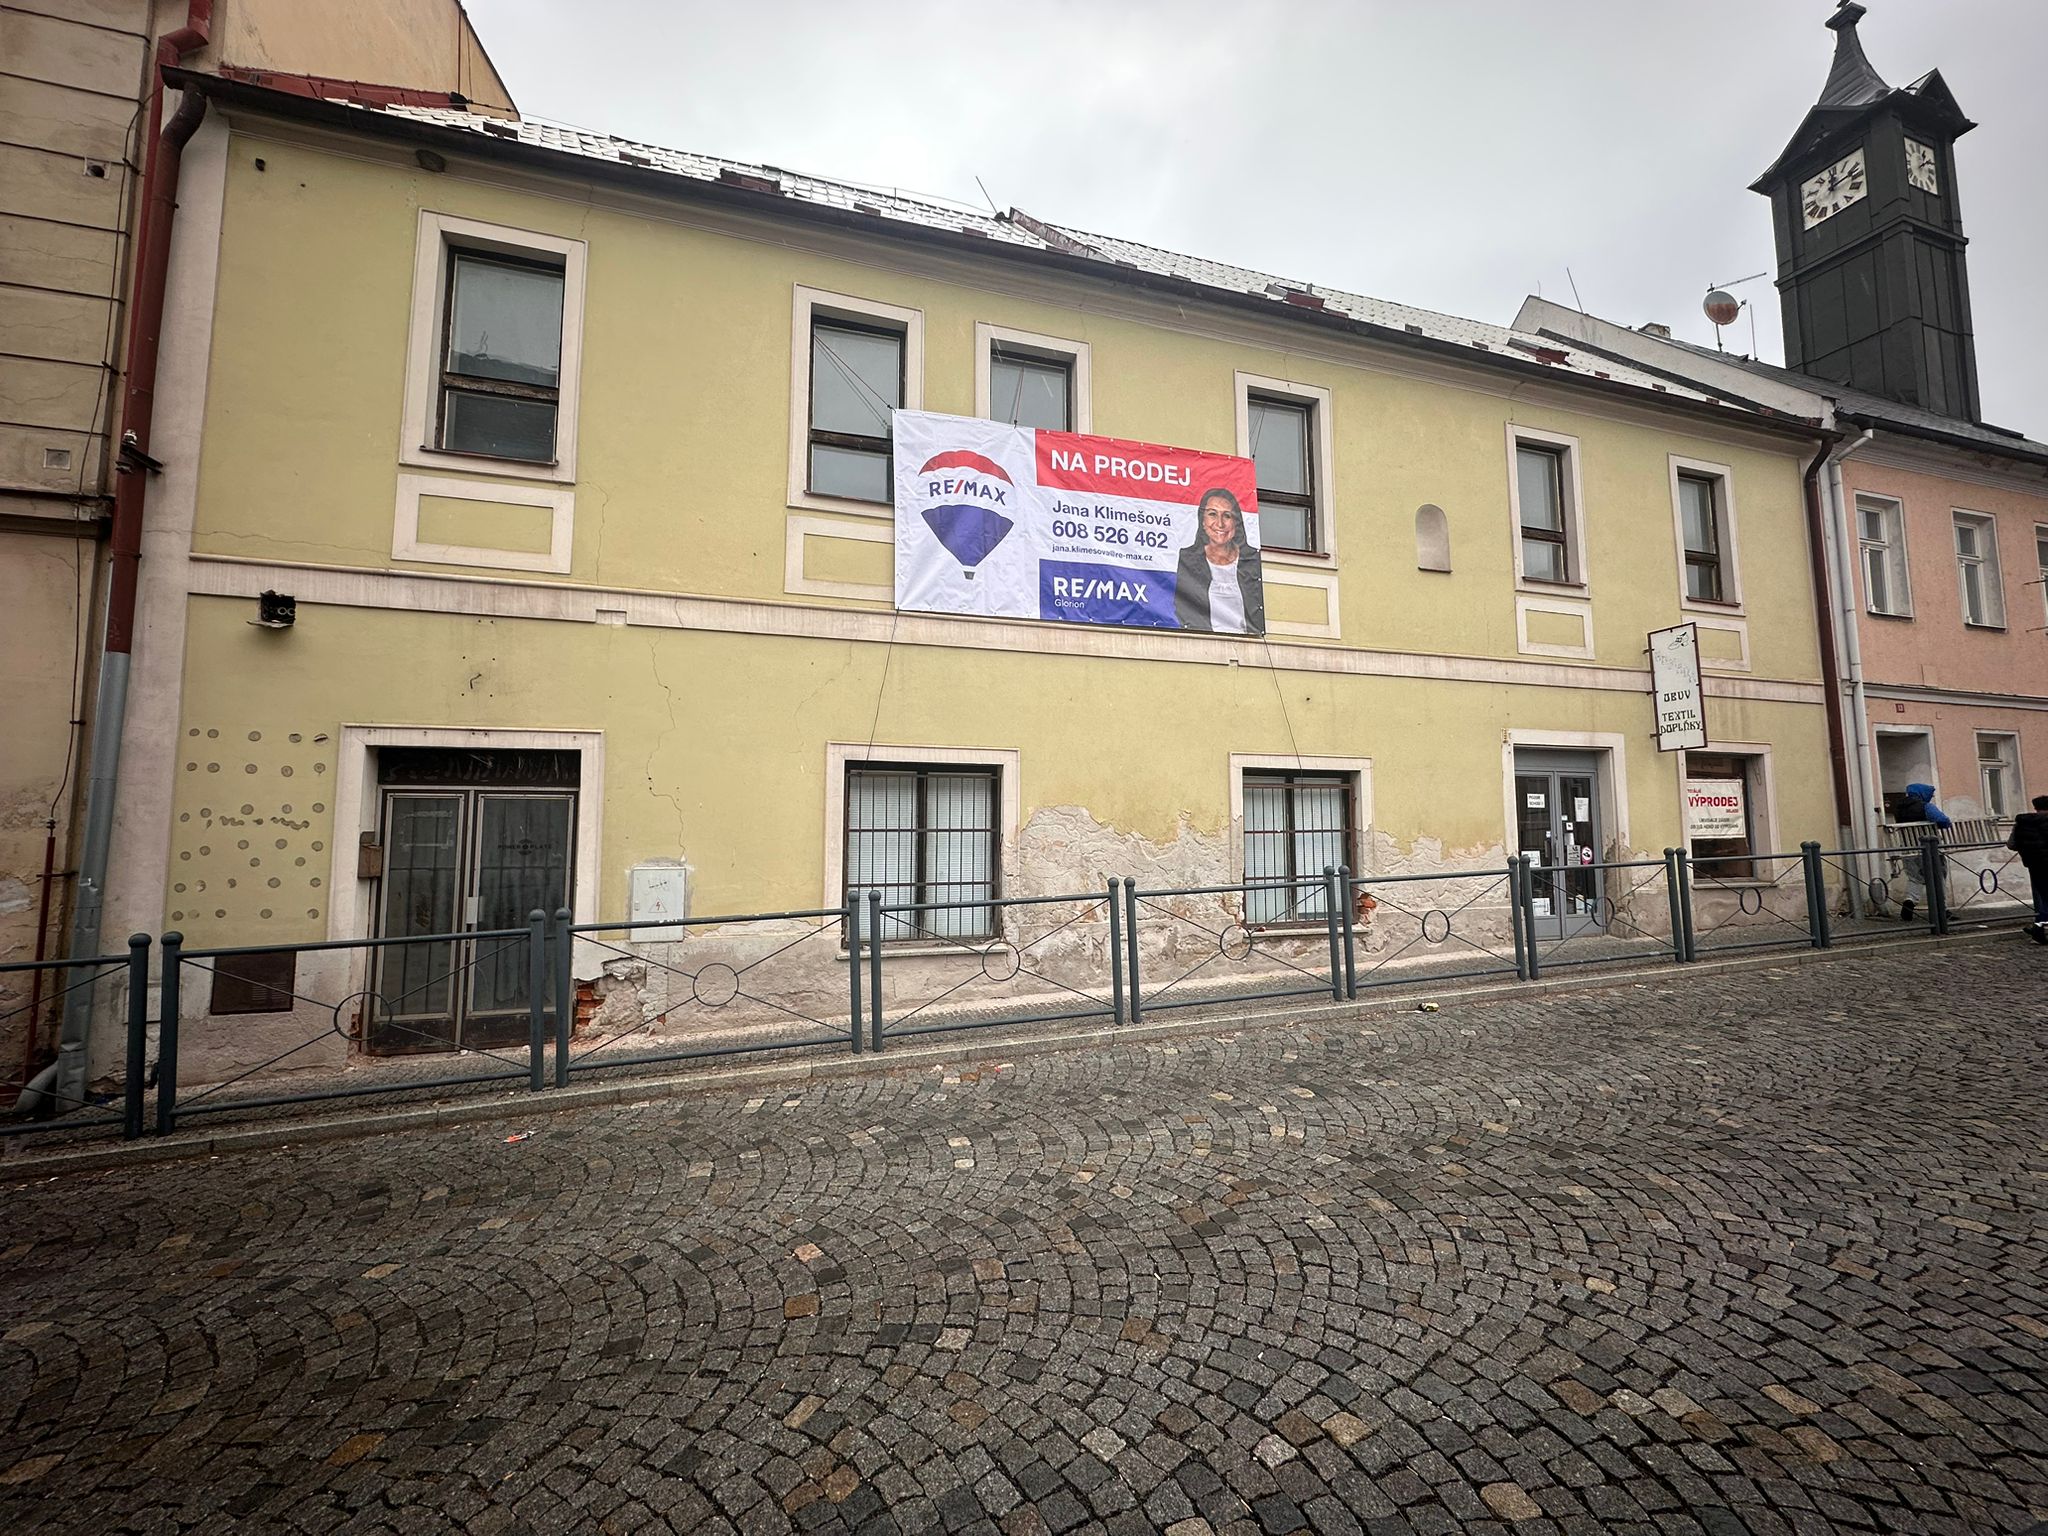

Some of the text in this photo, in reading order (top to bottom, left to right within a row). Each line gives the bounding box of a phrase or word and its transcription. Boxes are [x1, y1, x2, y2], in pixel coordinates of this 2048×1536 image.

[1051, 450, 1191, 487] NA PRODEJ
[929, 479, 1006, 506] RE/MAX
[1052, 500, 1172, 527] Jana Klimešová
[1052, 520, 1168, 549] 608 526 462
[1052, 544, 1153, 562] jana.klimesova@re-max.cz
[1053, 576, 1149, 603] RE/MAX
[1054, 598, 1085, 609] Glorion
[1663, 690, 1691, 703] OBUV
[1662, 709, 1696, 722] TEXTIL
[1660, 720, 1701, 734] DOPLŇKY
[1688, 794, 1738, 807] VÝPRODEJ
